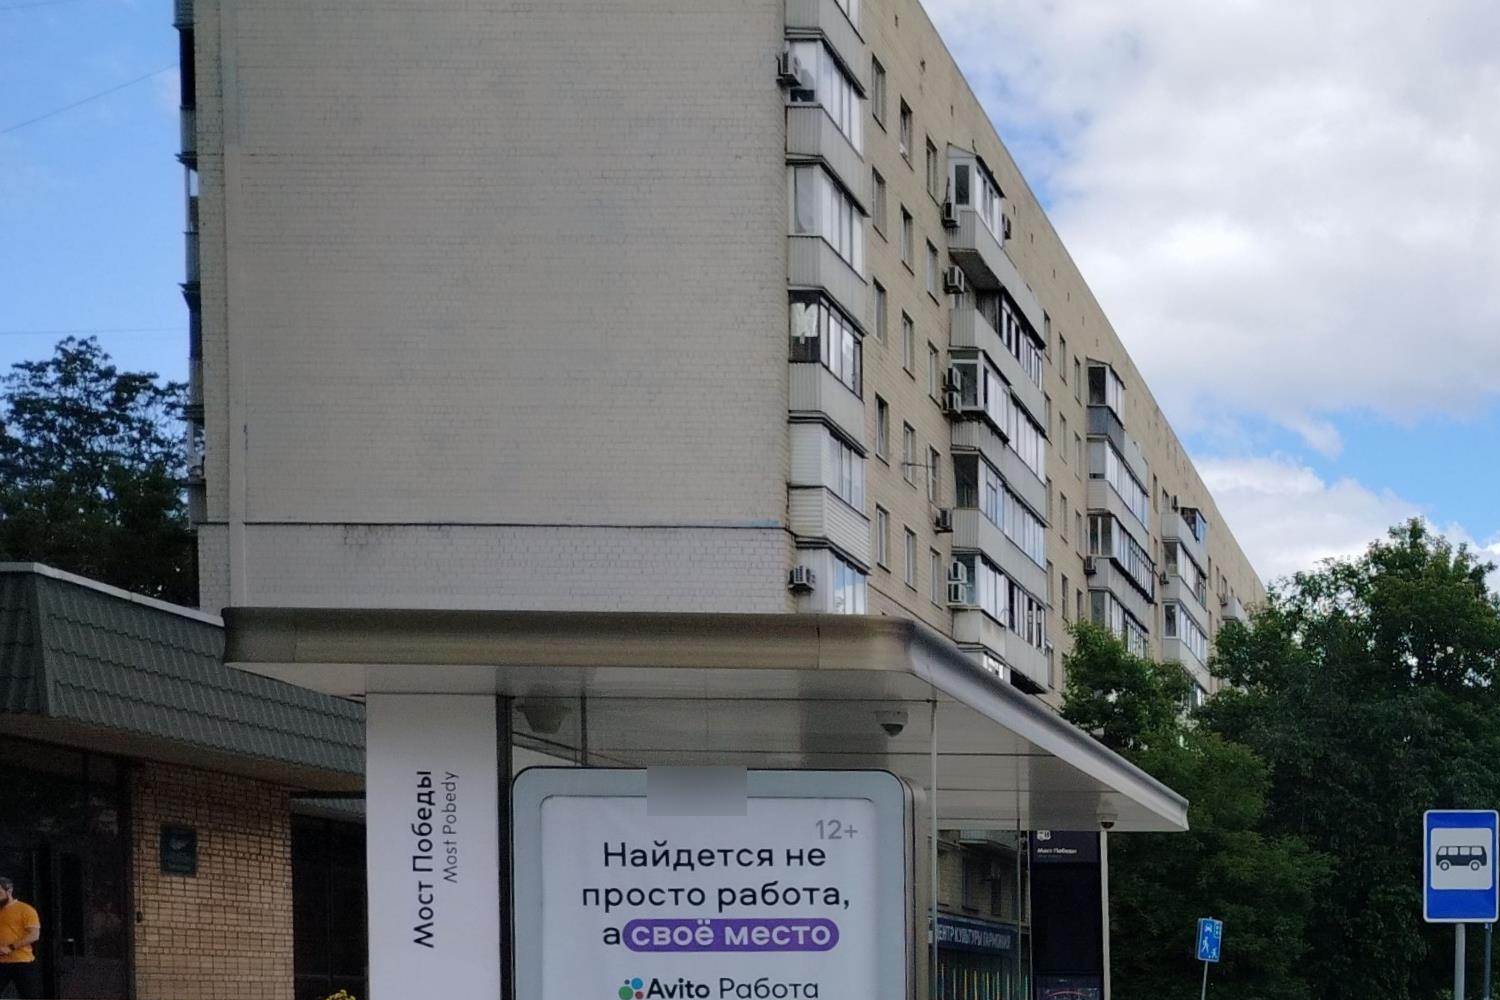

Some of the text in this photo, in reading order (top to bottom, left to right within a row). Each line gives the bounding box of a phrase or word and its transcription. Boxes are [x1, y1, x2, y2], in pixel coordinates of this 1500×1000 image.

[440, 770, 460, 884] Most Pobedy
[815, 819, 859, 840] 12+
[410, 770, 436, 949] Мост Победы
[602, 839, 826, 872] Найдется не
[582, 880, 851, 913] просто работа,
[602, 918, 831, 946] а своё место
[646, 977, 819, 1000] Avito Работа
